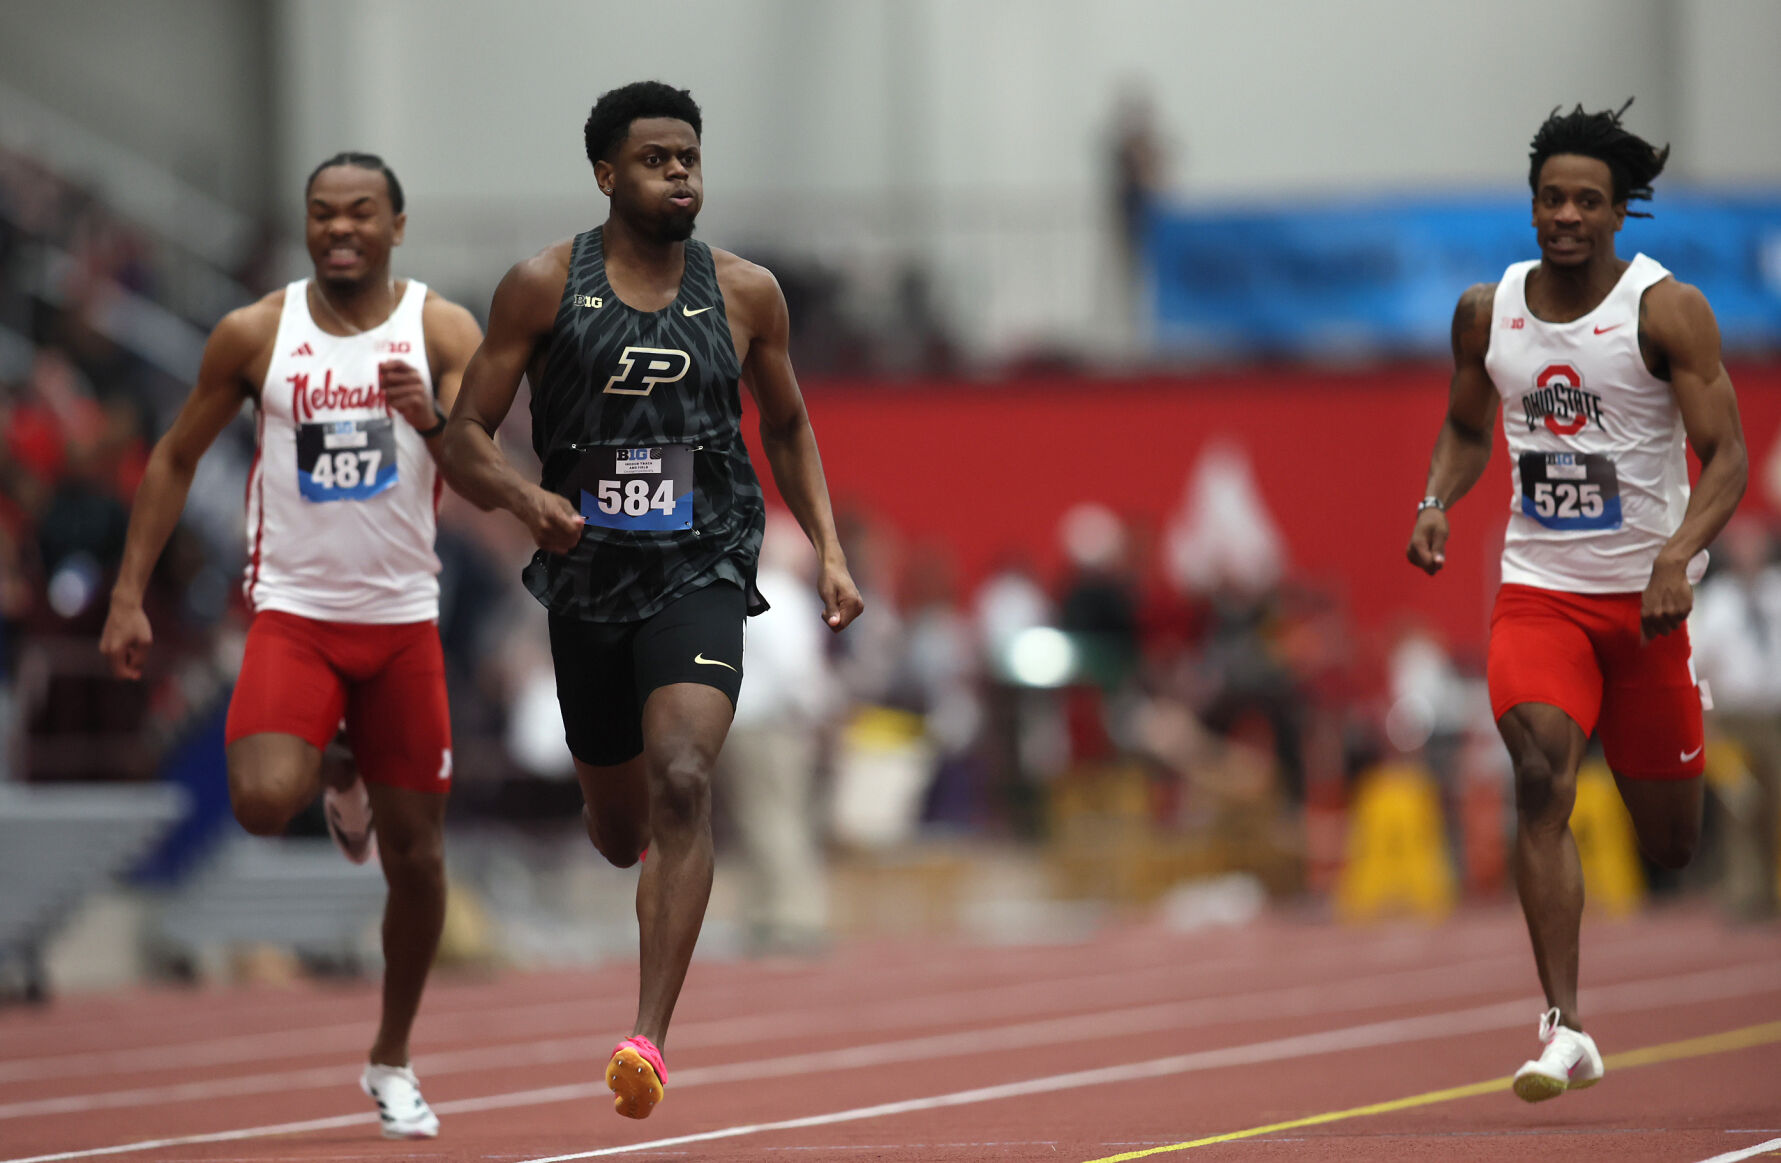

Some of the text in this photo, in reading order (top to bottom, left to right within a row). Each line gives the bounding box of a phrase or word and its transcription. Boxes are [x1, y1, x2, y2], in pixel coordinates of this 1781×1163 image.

[602, 346, 691, 396] P
[311, 449, 382, 489] 487
[598, 479, 677, 517] 584
[1534, 482, 1604, 519] 525
